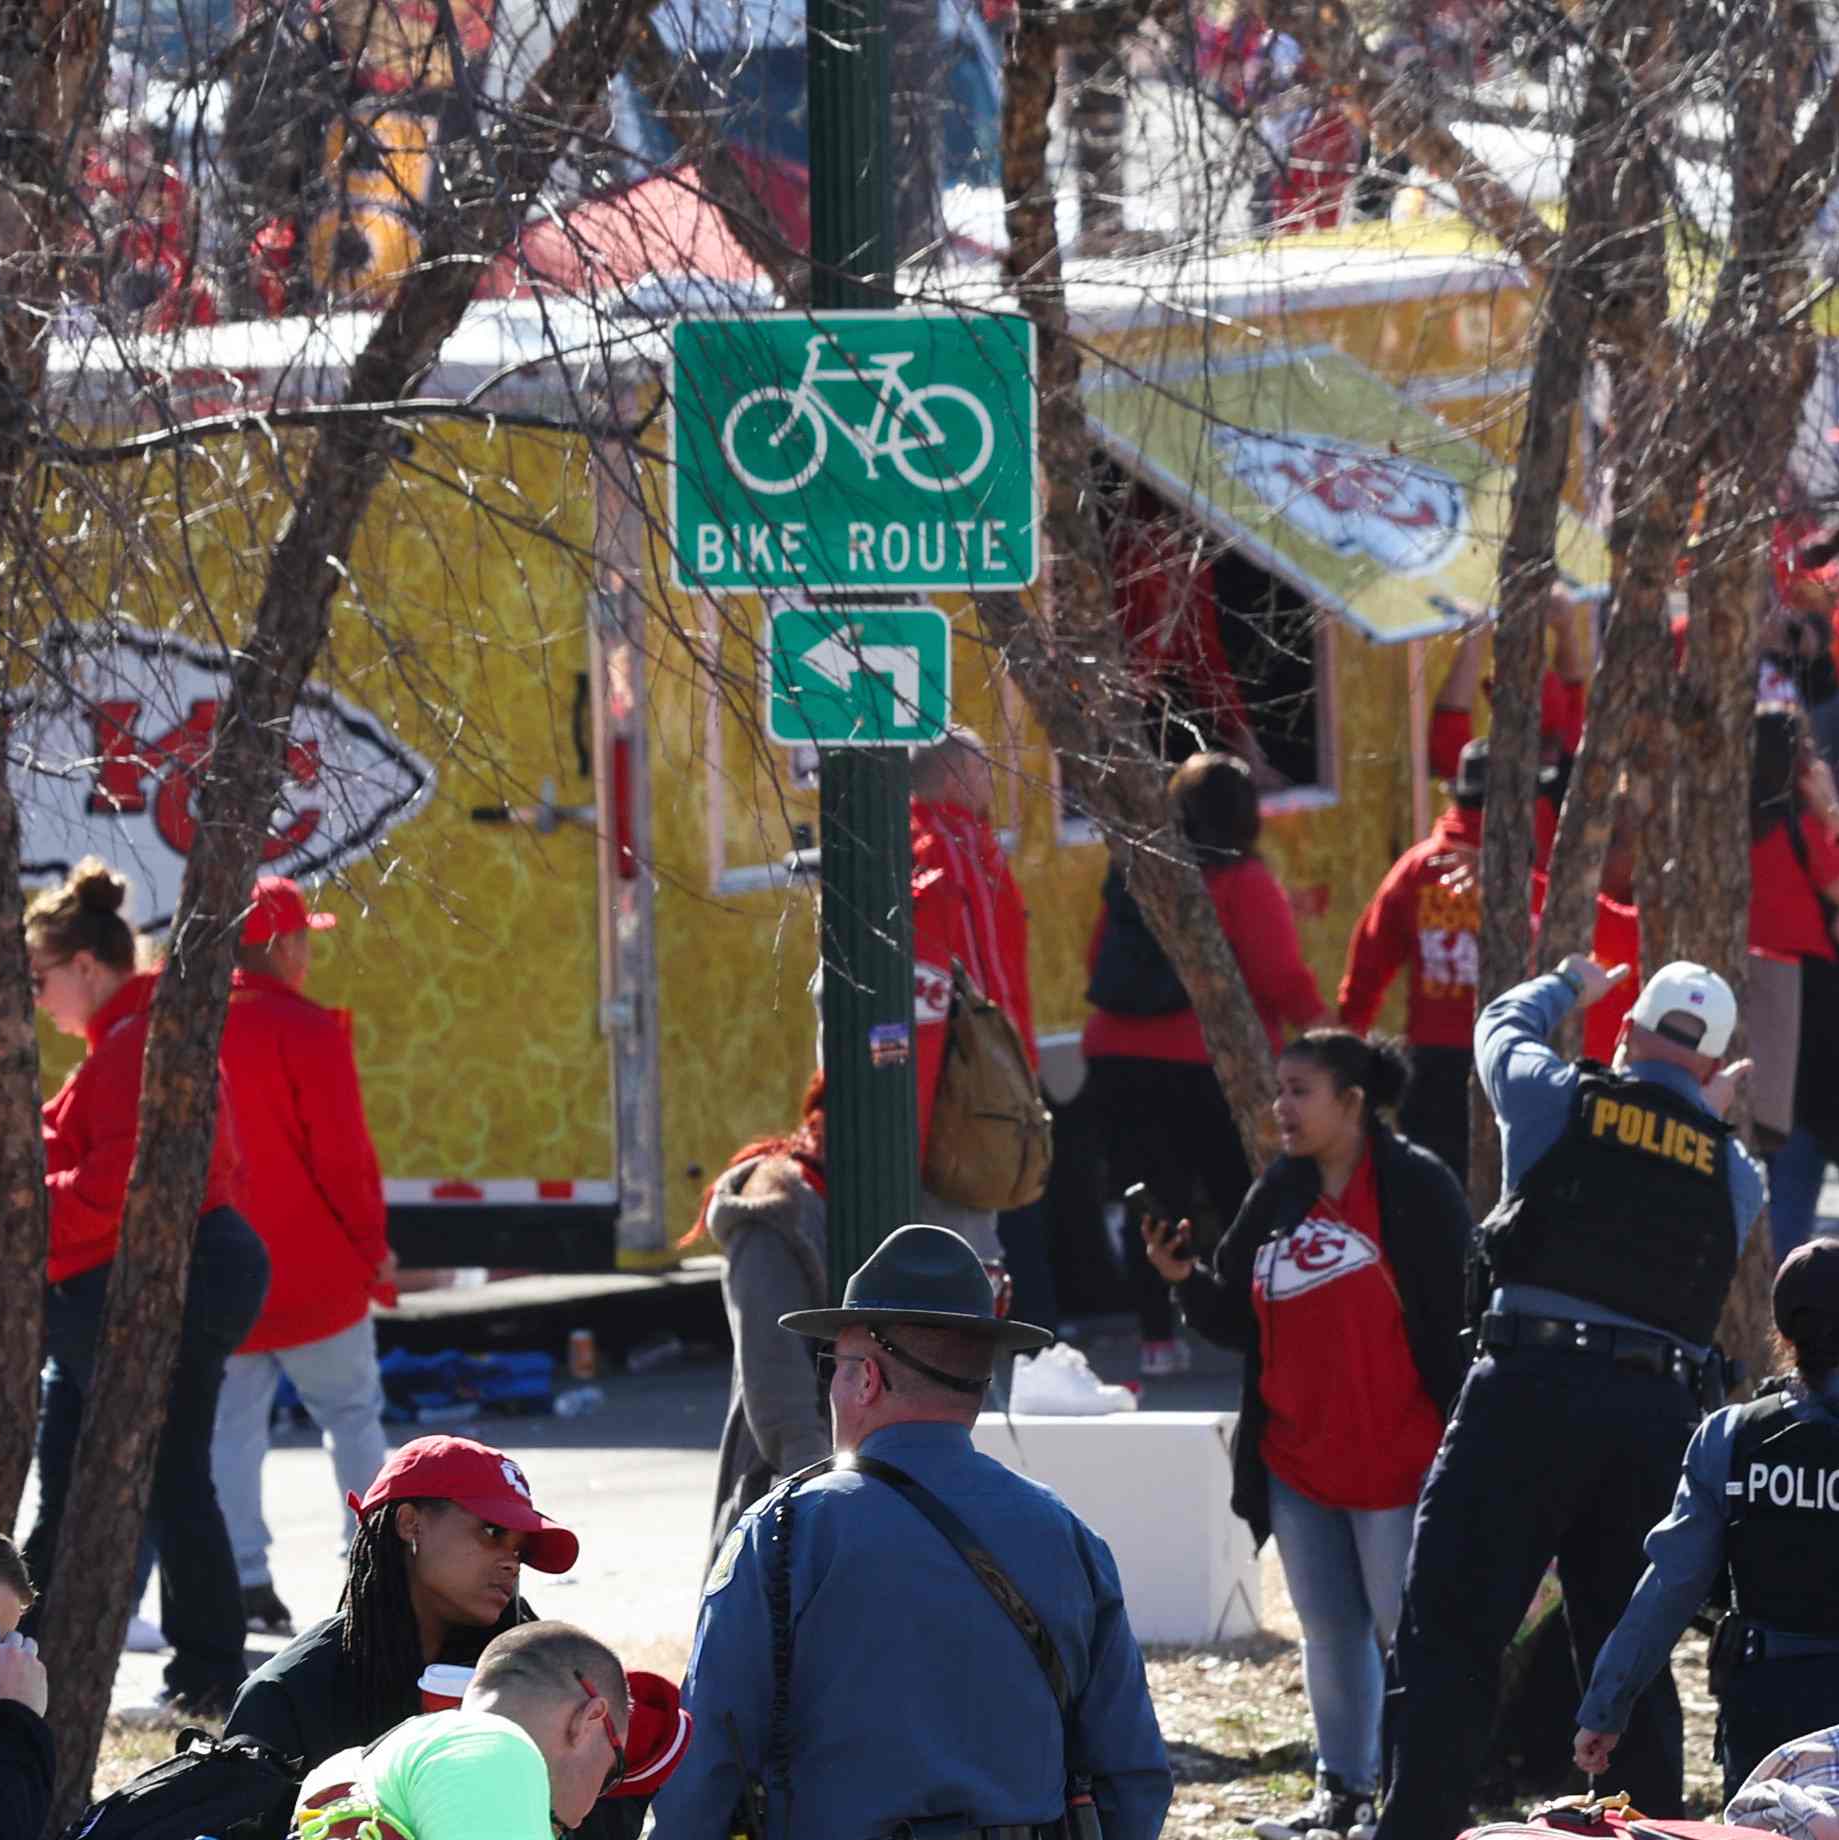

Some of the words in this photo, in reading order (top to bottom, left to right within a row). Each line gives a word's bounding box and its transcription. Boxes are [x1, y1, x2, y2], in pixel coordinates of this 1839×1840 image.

[697, 523, 807, 574] BIKE
[847, 520, 1008, 573] ROUTE
[1592, 1097, 1715, 1176] POLICE
